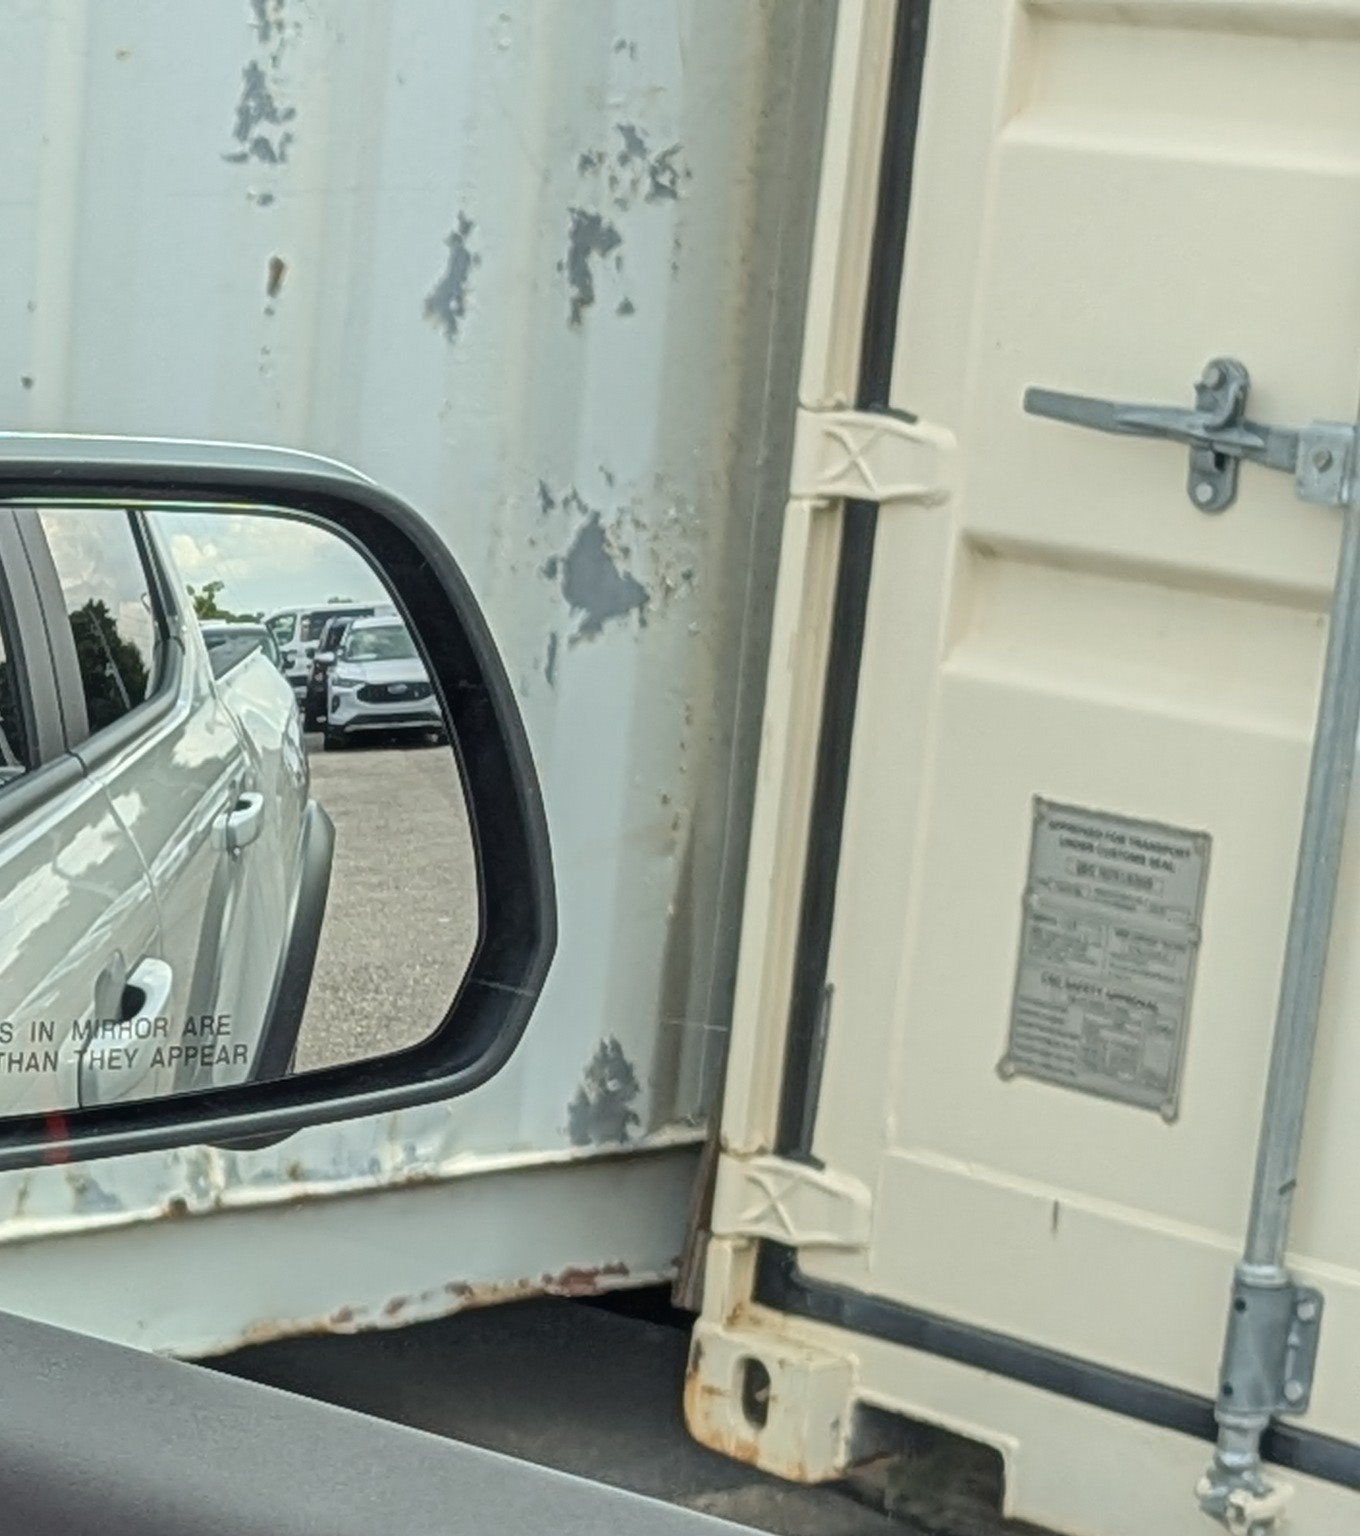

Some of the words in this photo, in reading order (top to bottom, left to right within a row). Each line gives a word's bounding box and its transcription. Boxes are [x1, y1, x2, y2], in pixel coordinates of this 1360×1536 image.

[30, 1020, 55, 1042] IN
[72, 1016, 168, 1041] MIRROR
[182, 1014, 231, 1037] ARE
[73, 1048, 138, 1071] THEY
[150, 1044, 248, 1068] APPEAR
